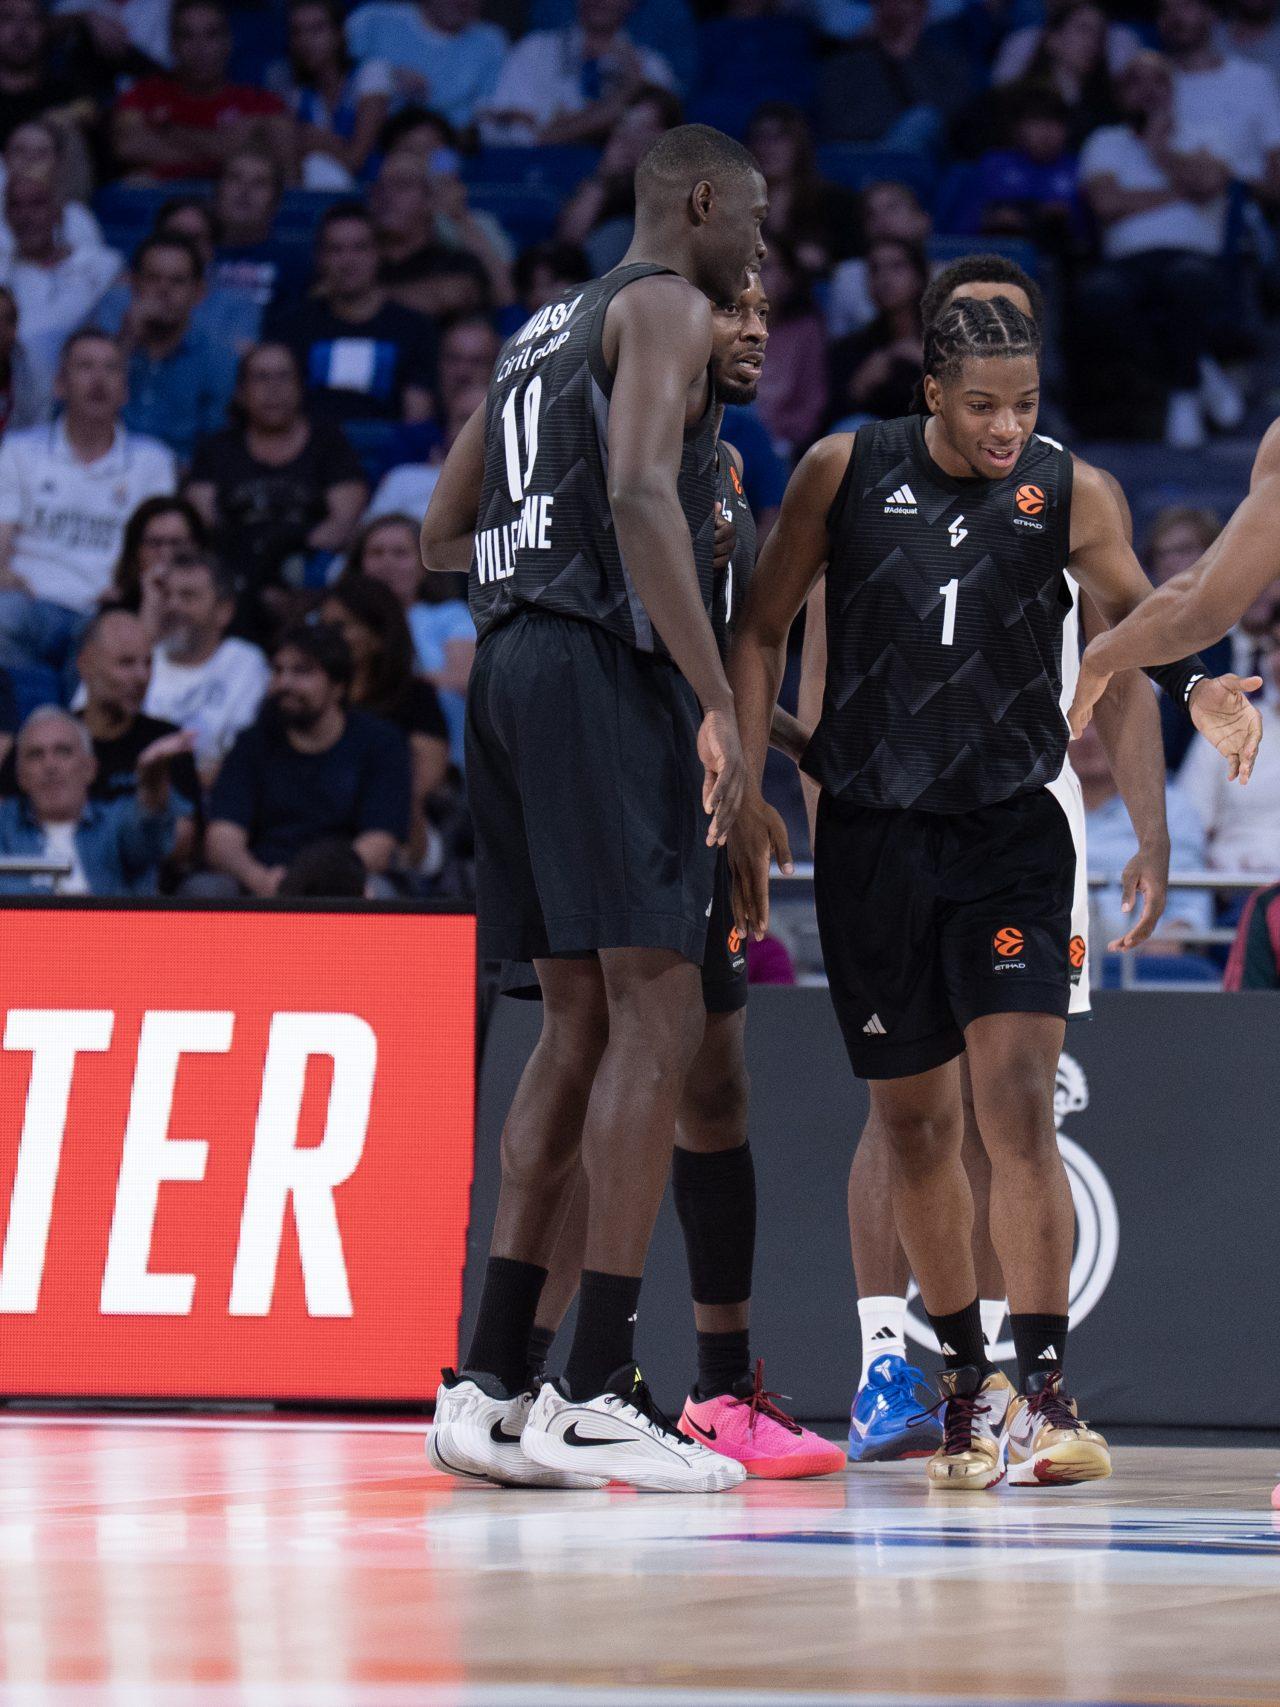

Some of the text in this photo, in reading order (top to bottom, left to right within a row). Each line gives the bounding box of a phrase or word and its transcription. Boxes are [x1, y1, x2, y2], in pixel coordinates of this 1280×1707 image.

[1013, 518, 1043, 530] ETIHAD
[939, 578, 959, 646] 1
[994, 963, 1026, 971] ETIHAD
[0, 1009, 377, 1318] TER
